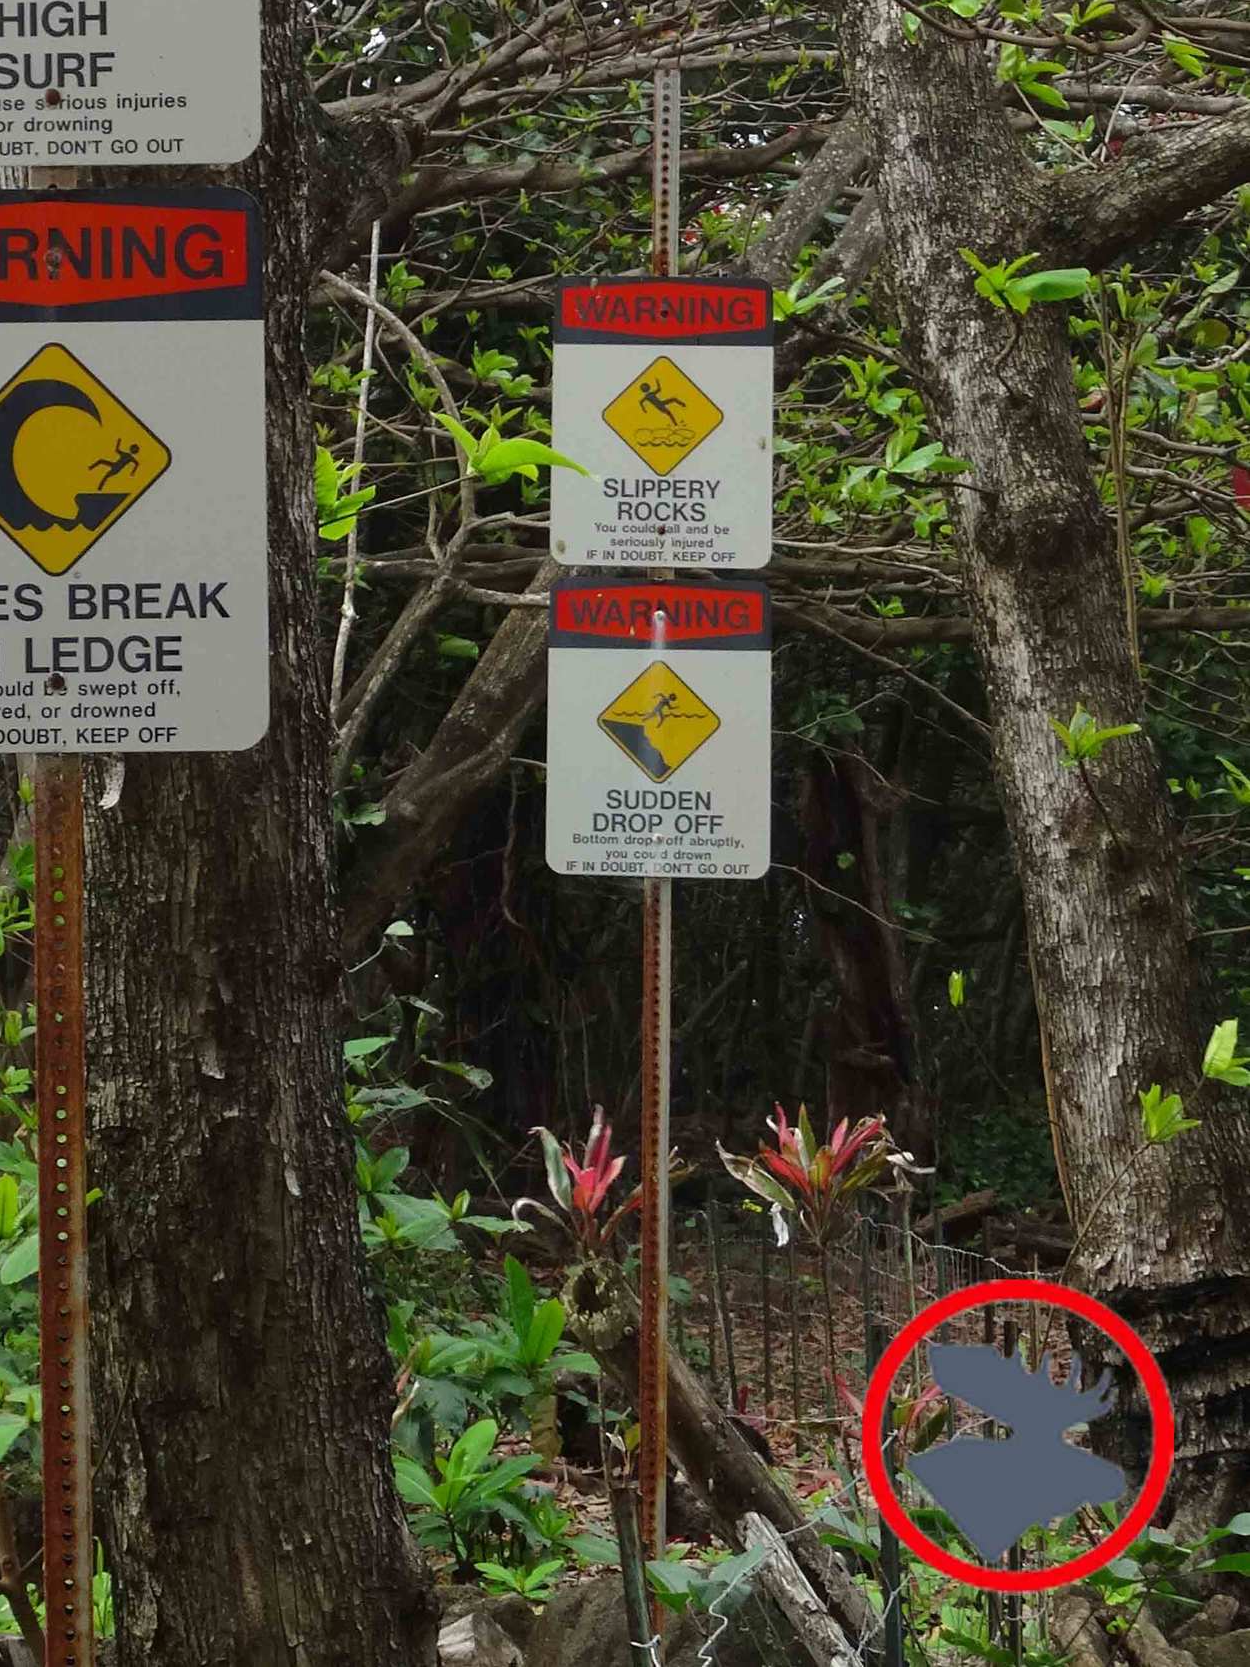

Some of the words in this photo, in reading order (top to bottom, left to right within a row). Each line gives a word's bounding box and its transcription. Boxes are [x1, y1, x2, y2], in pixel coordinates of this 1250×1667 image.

[35, 93, 106, 110] srious
[117, 92, 187, 110] injuries
[24, 116, 113, 134] drowning
[48, 140, 102, 155] DON'T
[111, 139, 139, 154] GO
[147, 139, 184, 153] OUT
[574, 296, 754, 325] WARNING
[603, 479, 720, 498] SLIPPERY
[618, 502, 706, 521] ROCKS
[594, 522, 616, 533] You
[622, 524, 655, 533] could
[657, 525, 680, 534] all
[686, 525, 708, 534] and
[714, 526, 730, 534] be
[610, 537, 666, 549] seriously
[672, 538, 713, 549] injured
[587, 550, 597, 559] IF
[603, 550, 615, 560] IN
[673, 552, 706, 562] KEEP
[711, 552, 736, 562] OFF
[69, 580, 231, 620] BREAK
[569, 598, 750, 629] WARNING
[25, 635, 182, 673] LEDGE
[78, 682, 137, 698] swept
[147, 680, 181, 696] off,
[41, 705, 61, 719] or
[71, 702, 156, 718] drowned
[76, 727, 129, 744] KEEP
[139, 727, 178, 743] OFF
[606, 789, 711, 810] SUDDEN
[593, 813, 662, 833] DROP
[675, 814, 724, 834] OFF
[573, 834, 618, 844] Bottom
[624, 835, 664, 847] drop
[666, 836, 683, 846] off
[606, 851, 627, 860] you
[634, 850, 668, 859] coud
[674, 850, 711, 860] drown
[566, 861, 577, 871] IF
[583, 862, 594, 871] IN
[698, 864, 717, 874] GO
[723, 864, 750, 874] OUT
